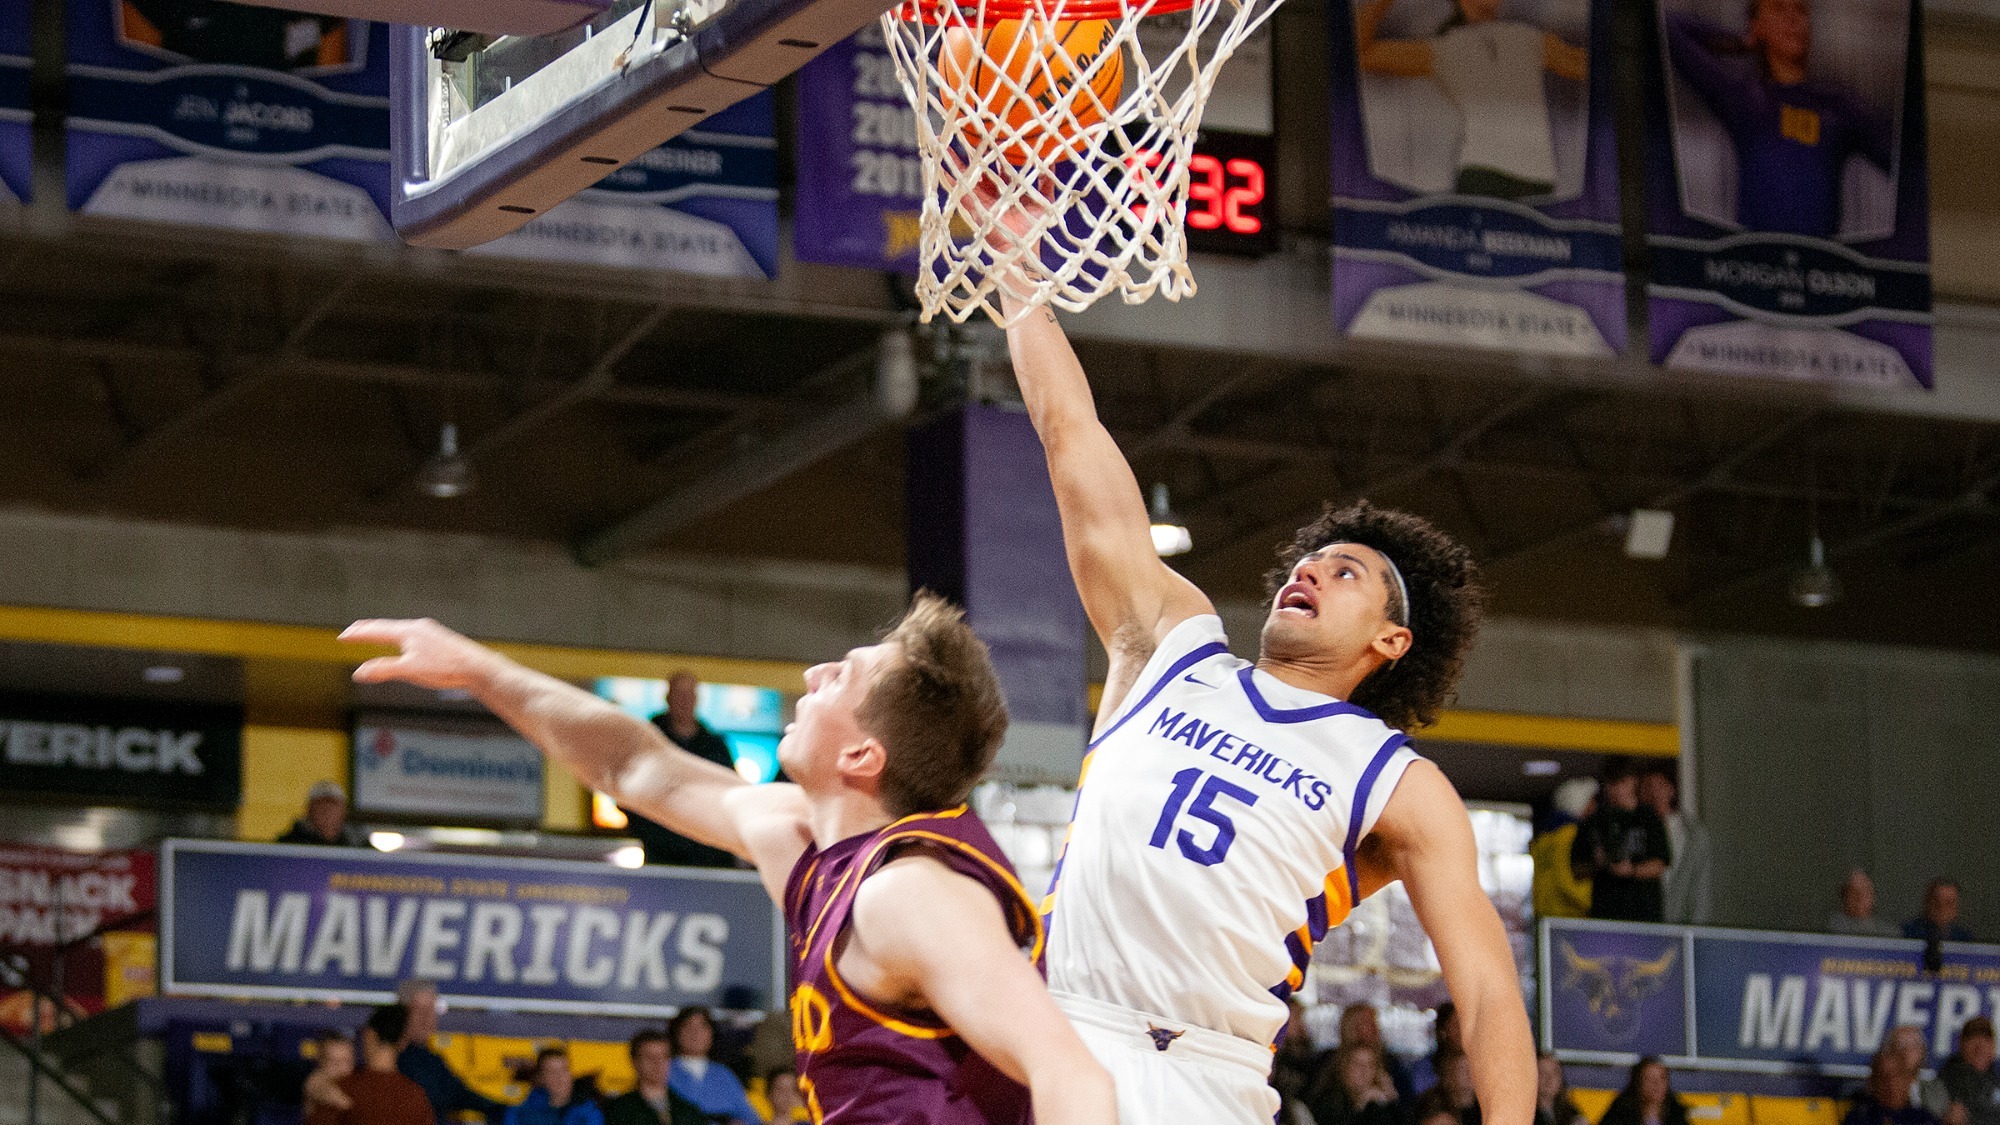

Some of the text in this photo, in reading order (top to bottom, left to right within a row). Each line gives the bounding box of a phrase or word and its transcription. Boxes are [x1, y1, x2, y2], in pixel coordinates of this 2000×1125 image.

[518, 221, 644, 246] INNESOTA
[1703, 258, 1804, 289] MORGAN
[1388, 304, 1575, 336] MINNESOTA STATE
[1700, 342, 1822, 369] MINNESOTA
[1147, 707, 1332, 811] MAVERICKS
[1148, 767, 1260, 867] 15
[227, 889, 729, 994] MAVERICKS
